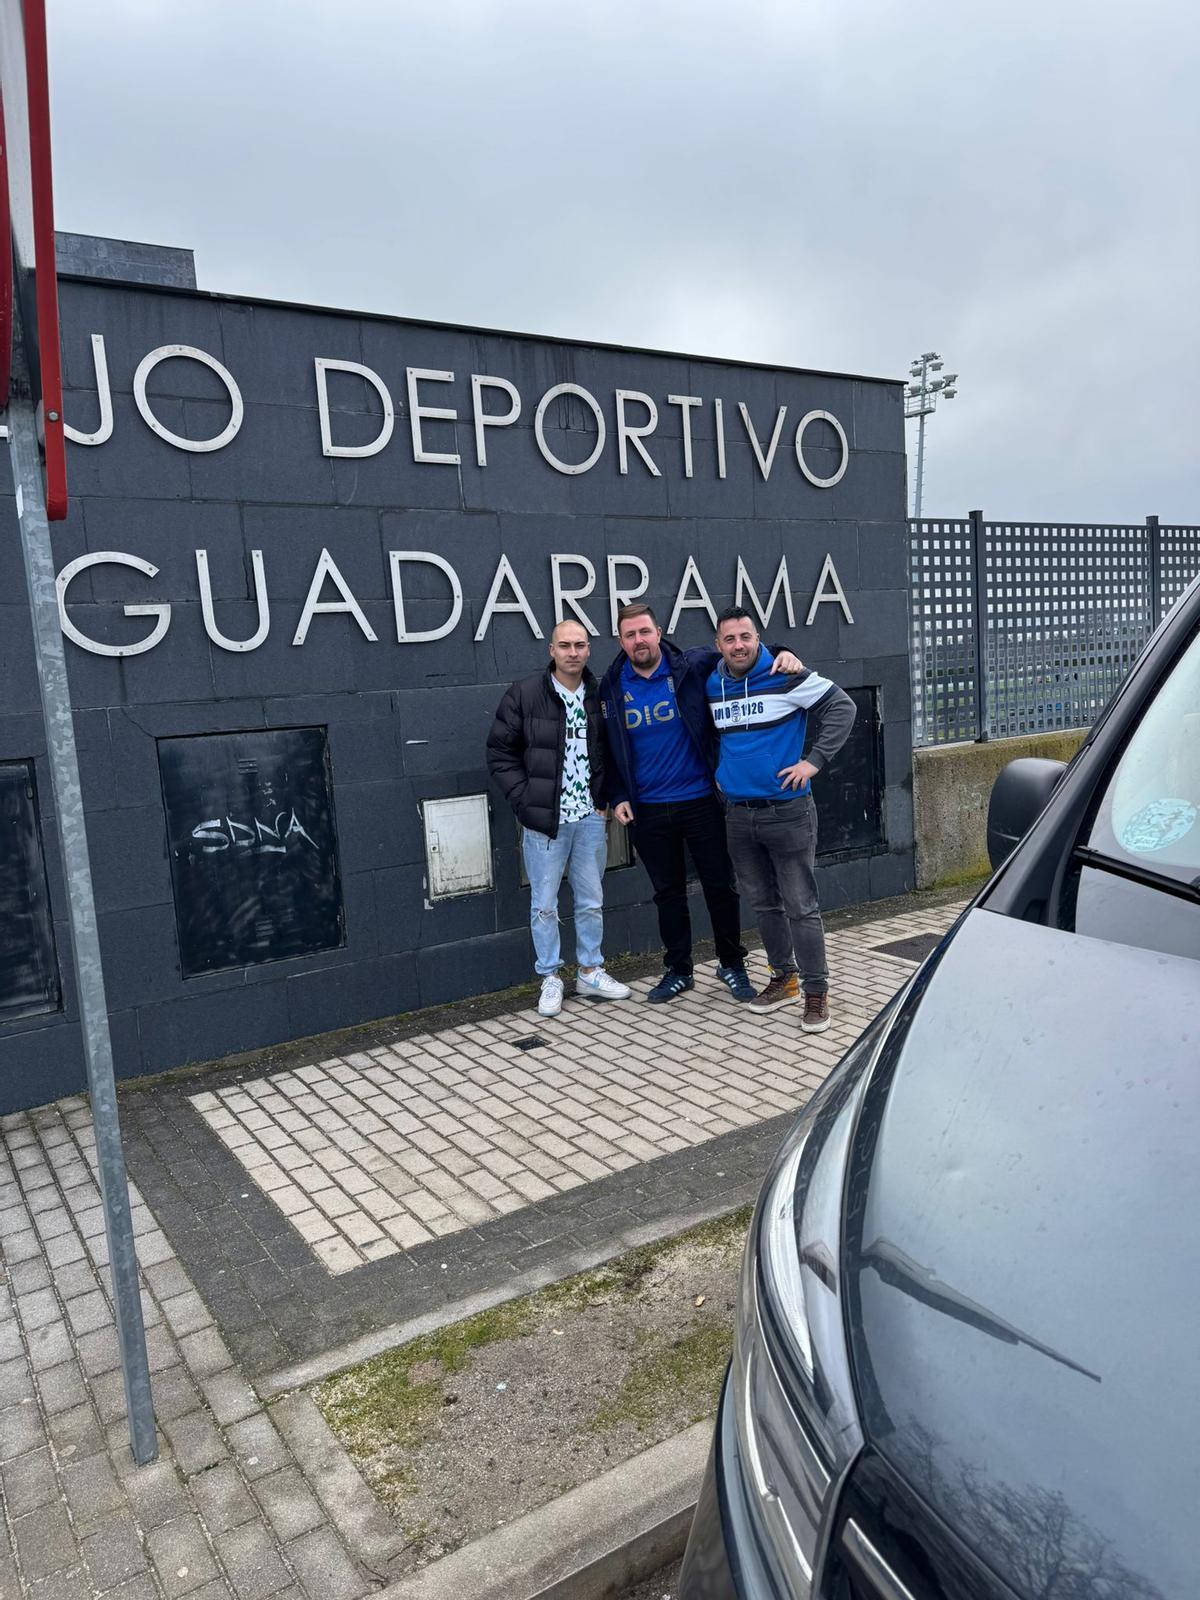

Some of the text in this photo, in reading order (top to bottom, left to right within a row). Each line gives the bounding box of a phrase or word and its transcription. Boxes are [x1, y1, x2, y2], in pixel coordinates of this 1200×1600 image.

[0, 334, 850, 489] JO DEPORTIVO
[55, 547, 855, 657] GUADARRAMA
[625, 697, 681, 729] DIG
